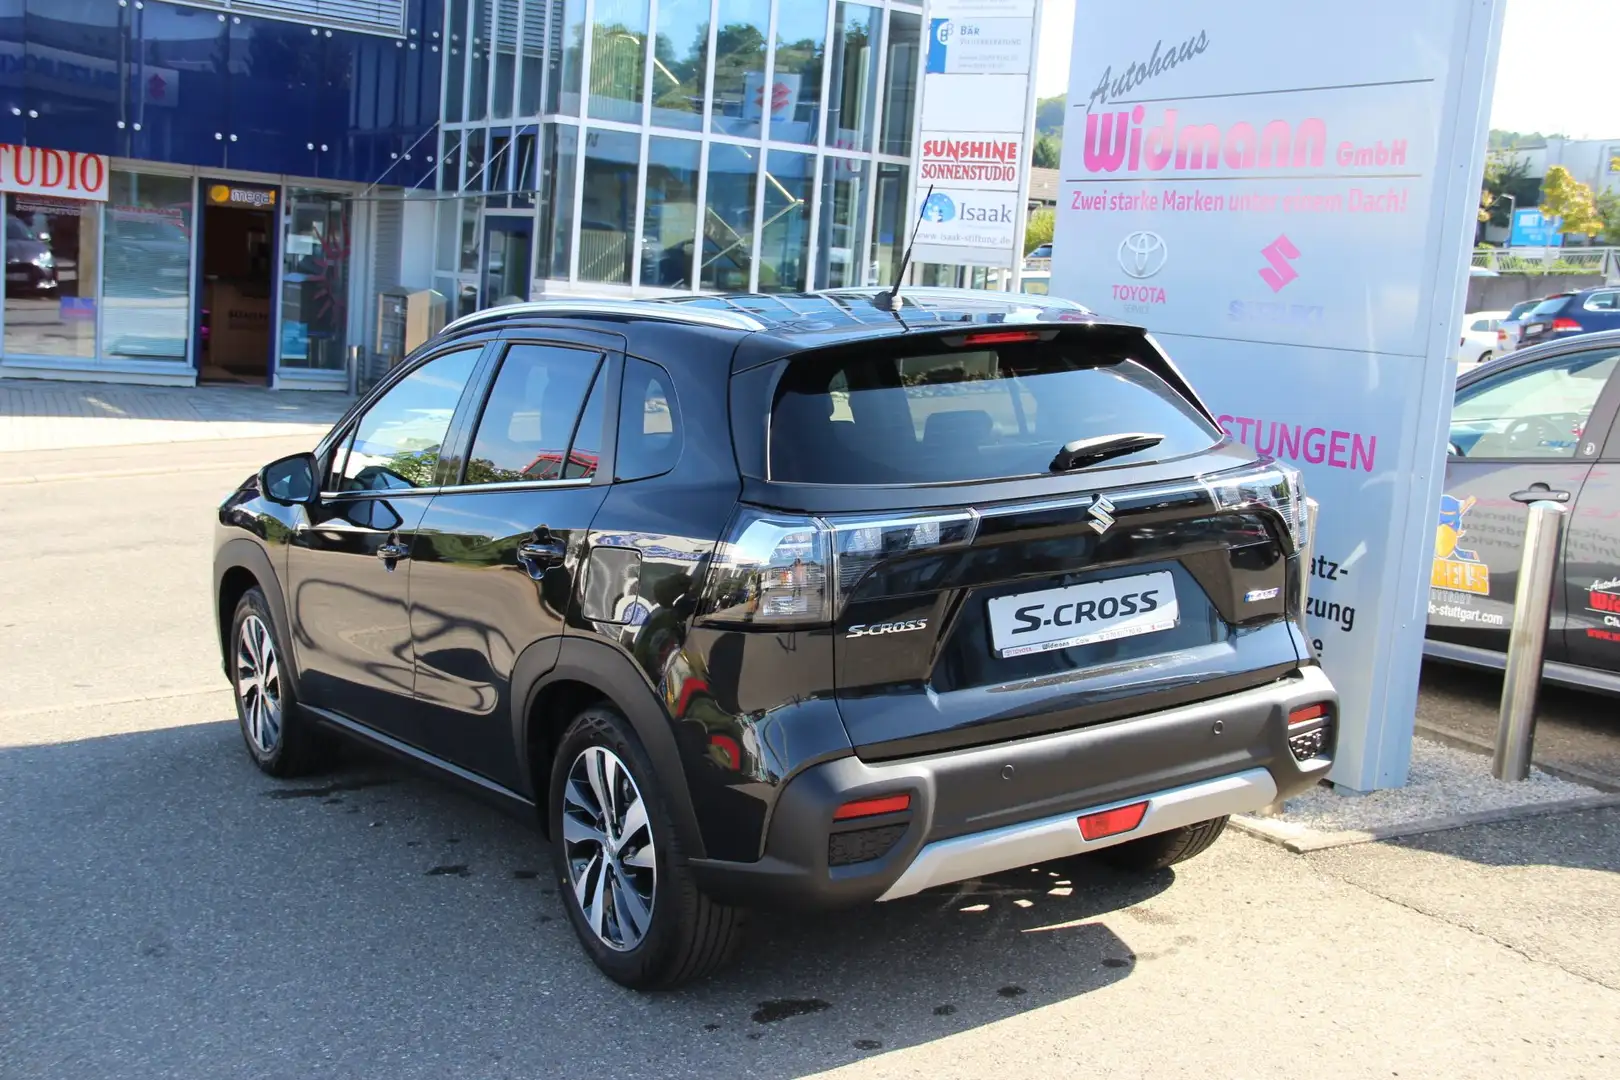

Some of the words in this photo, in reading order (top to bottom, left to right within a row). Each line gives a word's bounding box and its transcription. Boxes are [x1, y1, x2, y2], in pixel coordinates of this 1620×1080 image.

[1086, 29, 1210, 115] Autohaus
[923, 138, 1017, 164] SUNSHINE
[1083, 104, 1327, 173] Widmann
[1336, 139, 1408, 167] GmbH
[921, 163, 1015, 182] SONNENSTUDIO
[960, 202, 1012, 223] Isaak
[1071, 190, 1107, 211] Zwei
[1110, 190, 1158, 211] starke
[1162, 189, 1224, 212] Marken
[1228, 190, 1279, 212] unter
[1282, 187, 1343, 212] einem
[1348, 187, 1409, 213] Dach!
[1112, 284, 1167, 304] TOYOTA
[1011, 590, 1159, 635] S-CROSS
[1306, 597, 1355, 632] zung
[845, 618, 928, 639] S-CROSS
[1042, 640, 1070, 650] Widmann
